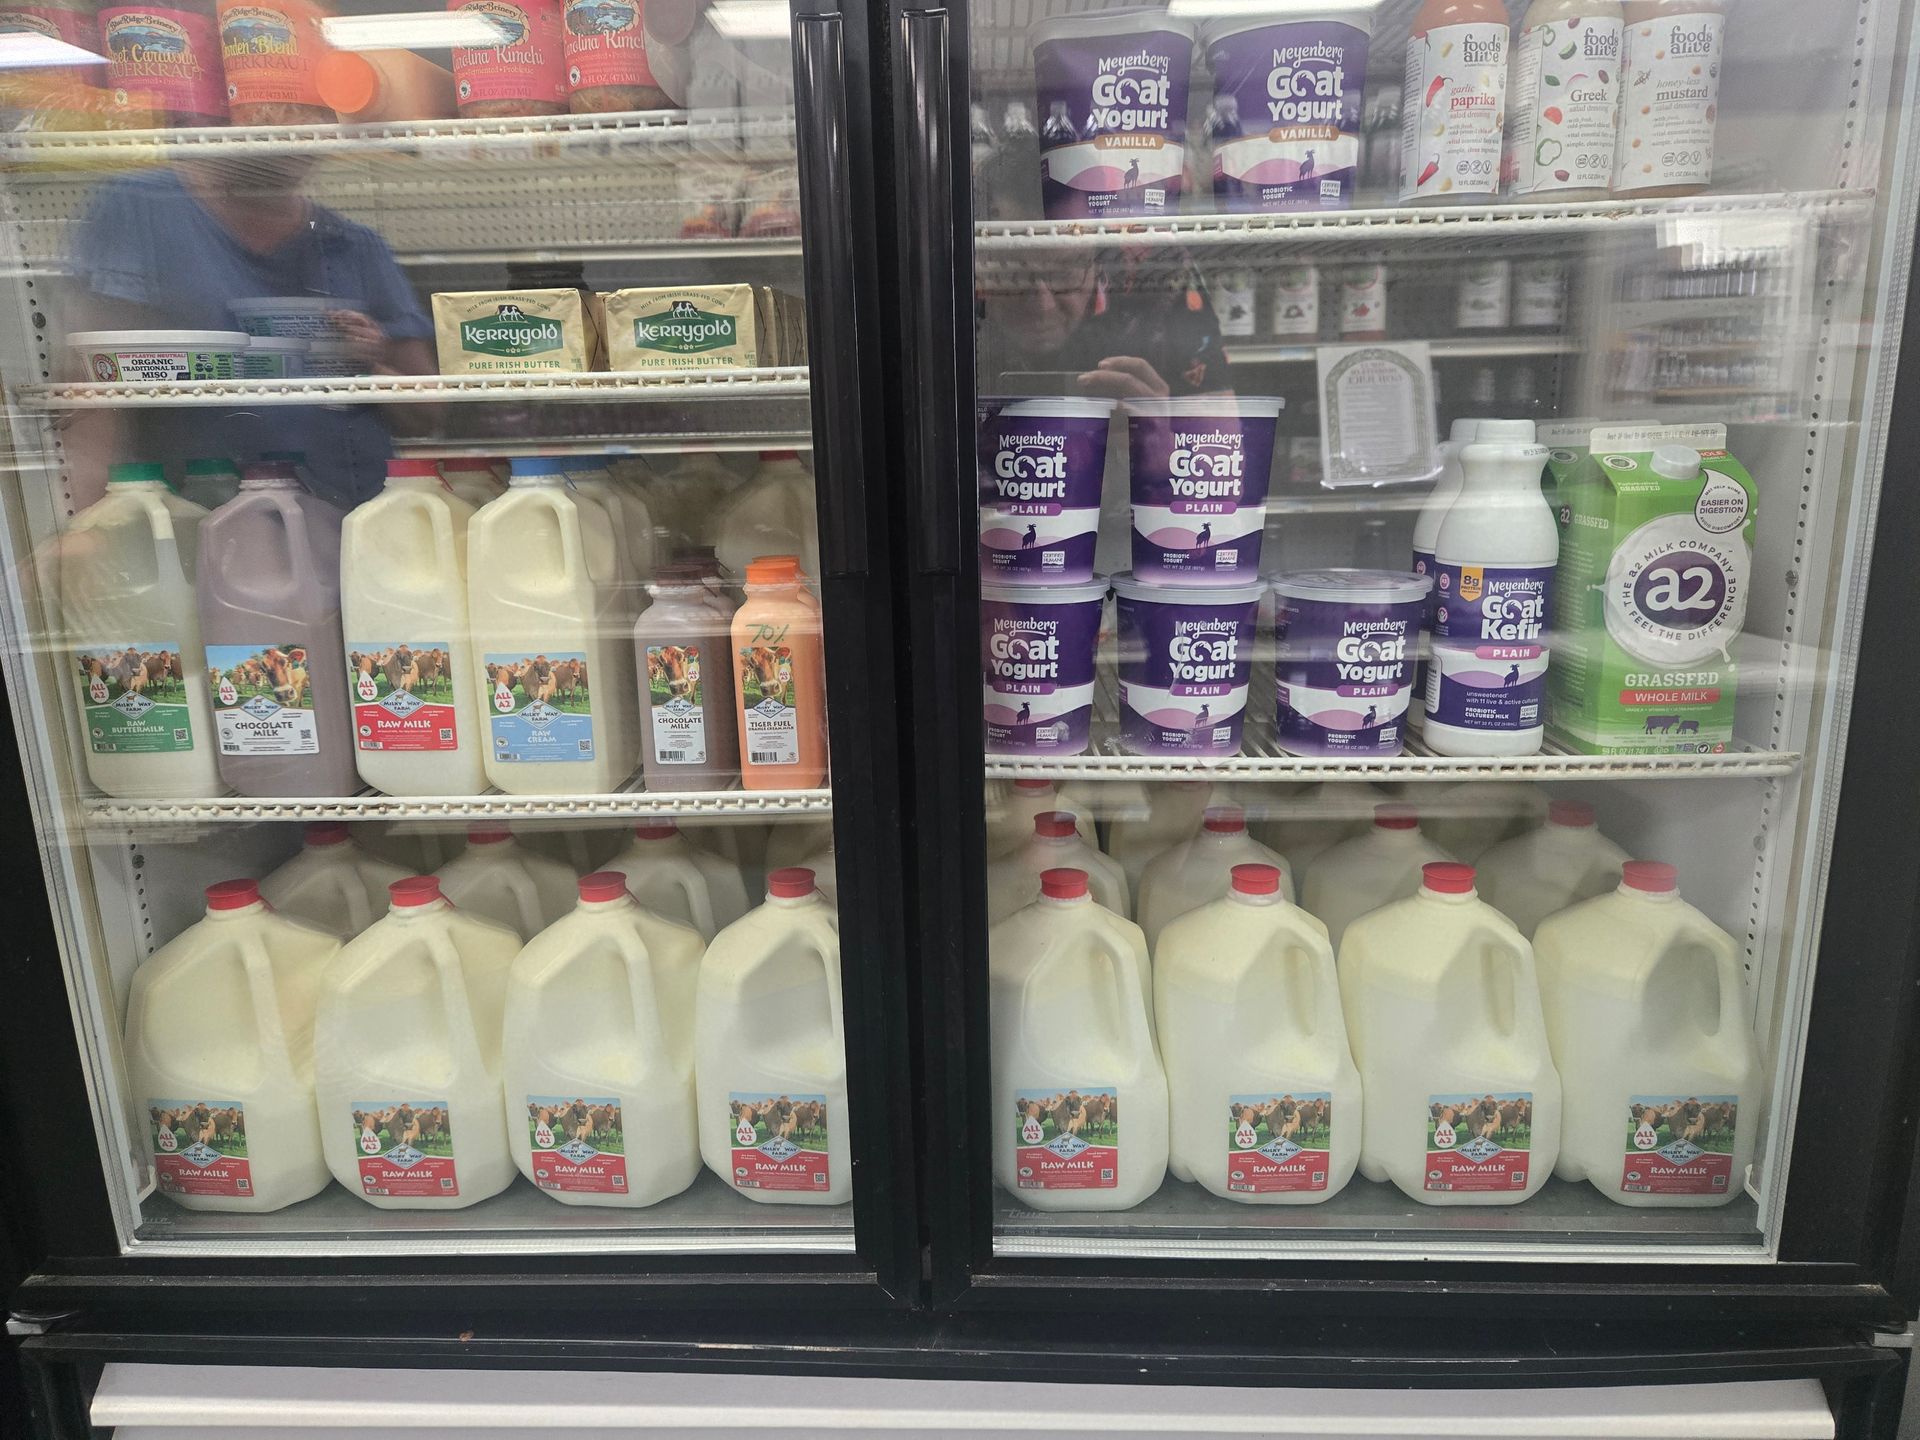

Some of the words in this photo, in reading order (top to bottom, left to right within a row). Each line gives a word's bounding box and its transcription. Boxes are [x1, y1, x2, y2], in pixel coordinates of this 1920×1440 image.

[1463, 33, 1501, 52] foods
[1584, 27, 1619, 46] foods
[1670, 24, 1712, 44] foods
[224, 37, 249, 57] arden
[494, 44, 544, 64] Kimchi
[1273, 40, 1344, 68] Meyenberg
[1584, 45, 1617, 57] alive
[1670, 42, 1710, 54] alive
[1098, 50, 1170, 76] Meyenberg
[1463, 51, 1499, 63] alive
[112, 62, 202, 80] AUERKRAUT
[1092, 74, 1170, 106] Goat
[1267, 66, 1344, 99] Goat
[1451, 83, 1475, 96] garlic
[1451, 93, 1496, 109] paprika
[1570, 88, 1607, 102] Greek
[1656, 86, 1708, 101] mustard
[1093, 108, 1168, 130] Yogurt
[1267, 100, 1342, 122] Yogurt
[1105, 137, 1156, 147] VANILLA
[1280, 127, 1332, 139] VANILLA
[1262, 186, 1293, 194] PROBIOTIC
[465, 323, 558, 346] Kerrygold
[638, 319, 732, 342] Kerrygold
[469, 361, 493, 370] PURE
[496, 360, 520, 369] IRISH
[524, 360, 560, 369] BUTTER
[642, 358, 665, 367] PURE
[668, 357, 694, 366] IRISH
[697, 356, 734, 365] BUTTER
[999, 430, 1067, 453] Meyenberg
[1174, 429, 1244, 452] Meyenberg
[995, 450, 1067, 479] Goat
[1169, 449, 1244, 477] Goat
[996, 480, 1066, 500] Yogurt
[1169, 478, 1241, 499] Yogurt
[1011, 505, 1048, 514] PLAIN
[1185, 504, 1223, 513] PLAIN
[1700, 506, 1744, 514] DIGESTION
[1731, 498, 1744, 506] ON
[1561, 508, 1570, 523] a2
[1574, 514, 1609, 529] GRASSFED
[1463, 575, 1480, 587] 8g
[1623, 582, 1632, 607] THE
[1644, 542, 1674, 561] MILK
[1679, 540, 1735, 573] COMPANY
[1488, 577, 1544, 598] Meyenberg
[1645, 566, 1716, 612] a2
[1481, 595, 1544, 619] Goat
[1629, 610, 1654, 633] FEEL
[1659, 629, 1682, 641] THE
[1688, 577, 1737, 640] DIFFERENCE
[994, 617, 1059, 636] Meyenberg
[1175, 618, 1239, 639] Meyenberg
[1344, 618, 1408, 639] Meyenberg
[1481, 619, 1542, 640] Kefir
[990, 633, 1059, 660] Goat
[1169, 636, 1238, 662] Goat
[1337, 636, 1407, 663] Goat
[1493, 649, 1530, 657] PLAIN
[991, 659, 1059, 680] Yogurt
[1169, 662, 1236, 683] Yogurt
[1336, 662, 1403, 683] Yogurt
[91, 683, 106, 691] ALL
[1624, 671, 1719, 687] GRASSFED
[496, 692, 511, 700] ALL
[1006, 684, 1040, 693] PLAIN
[1185, 686, 1220, 695] PLAIN
[1353, 687, 1388, 696] PLAIN
[1635, 692, 1679, 702] WHOLE
[1681, 691, 1708, 701] MILK
[235, 721, 293, 730] CHOCOLATE
[253, 729, 278, 737] MILK
[377, 720, 400, 728] RAW
[403, 720, 431, 728] MILK
[555, 1165, 577, 1173] RAW
[755, 1163, 778, 1171] RAW
[780, 1164, 807, 1172] MILK
[1041, 1161, 1065, 1169] RAW
[1067, 1161, 1094, 1169] MILK
[1253, 1165, 1278, 1173] RAW
[1279, 1164, 1306, 1173] MILK
[1478, 1164, 1506, 1172] MILK
[1678, 1167, 1708, 1175] MILK
